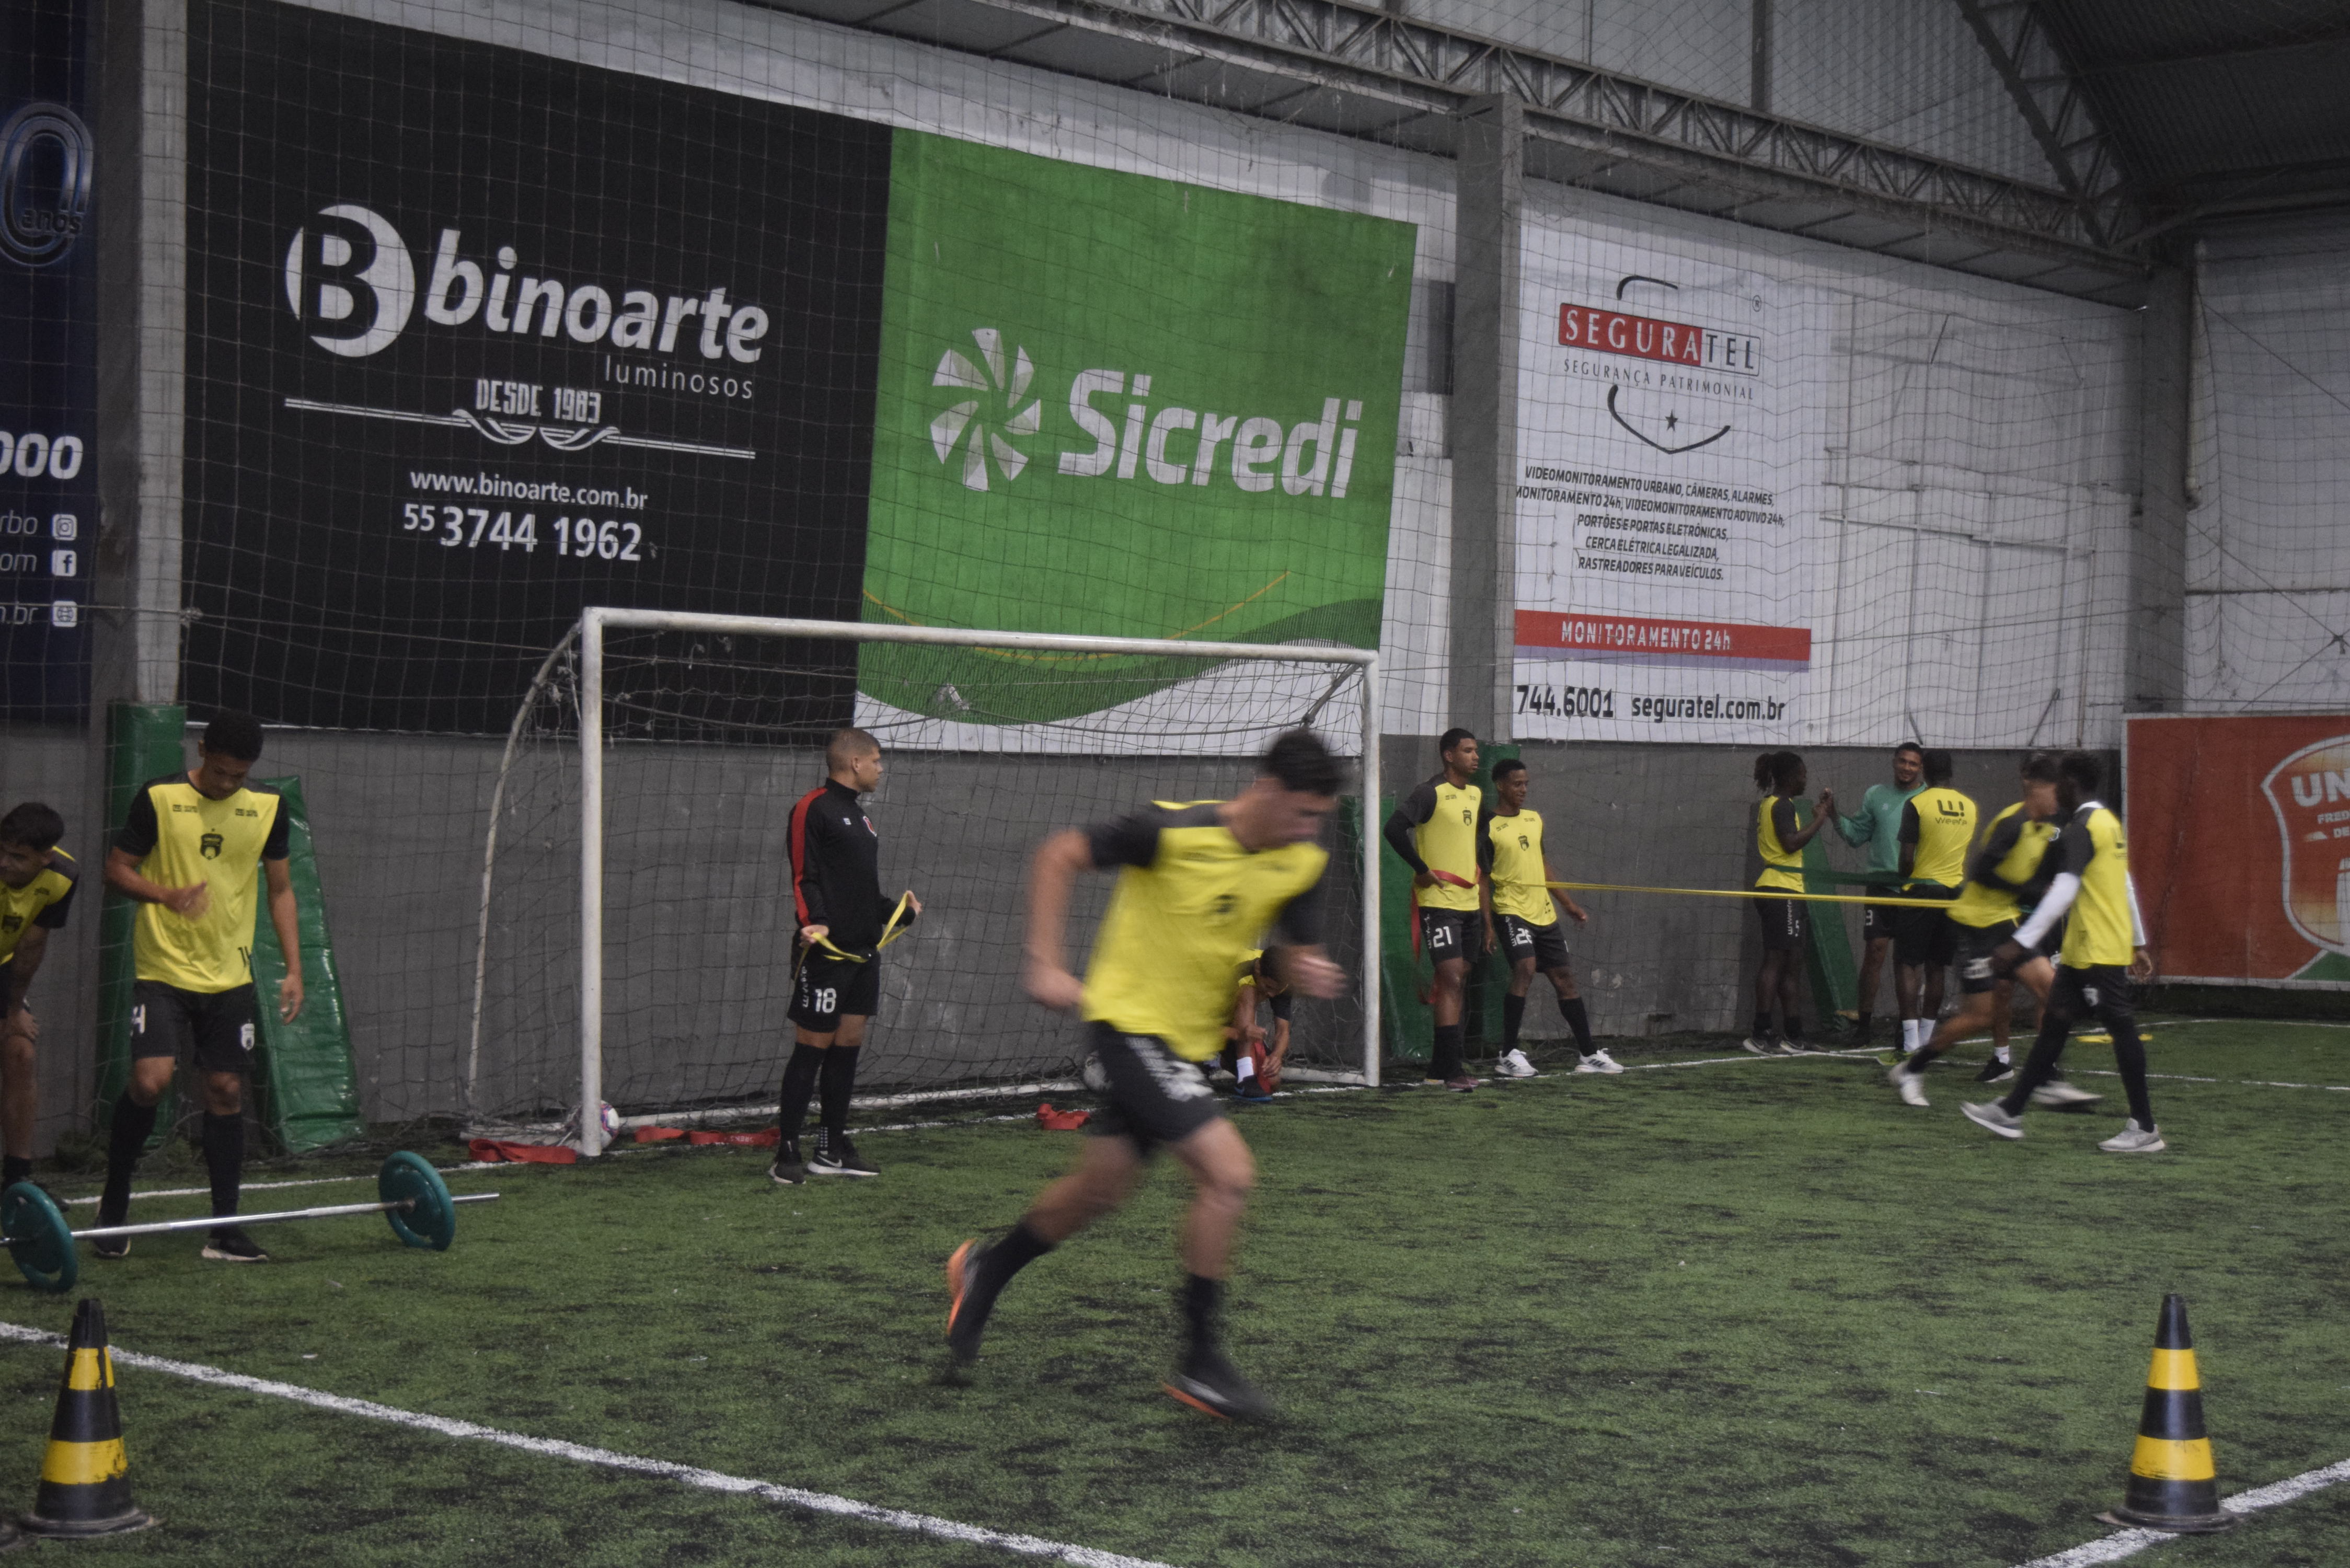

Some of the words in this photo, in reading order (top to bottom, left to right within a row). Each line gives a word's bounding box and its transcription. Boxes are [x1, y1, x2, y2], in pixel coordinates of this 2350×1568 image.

[21, 209, 82, 236] anos
[425, 228, 769, 363] binoarte
[1565, 309, 1754, 370] SEGURATEL
[605, 355, 753, 399] luminosos
[1564, 359, 1650, 386] SEGURANÇA
[1661, 373, 1753, 400] PATRIMONIAL
[476, 379, 543, 417] DESDE
[554, 387, 601, 424] 1983
[1058, 368, 1363, 498] Sicredi
[410, 471, 648, 510] www.binoarte.com.br
[1525, 465, 1642, 490] VIDEOMONITORAMENTO
[1643, 480, 1684, 498] URBANO,
[1685, 482, 1730, 503] CÂMERAS,
[1731, 490, 1775, 507] ALARMES,
[1516, 486, 1602, 506] MONITORAMENTO
[1603, 495, 1623, 511] 24h,
[1625, 498, 1733, 521] VIDEOMONITORAMENTO
[1767, 513, 1785, 528] 24h,
[404, 503, 435, 532] 55
[440, 506, 538, 552] 3744
[552, 516, 642, 561] 1962
[1577, 514, 1621, 531] PORTÕES
[1622, 518, 1629, 531] E
[1629, 520, 1665, 534] PORTAS
[1666, 523, 1729, 543] ELETRÔNICAS,
[1585, 536, 1616, 550] CERCA
[1617, 537, 1662, 555] ELÉTRICA
[1662, 544, 1720, 561] LEGALIZADA,
[1578, 556, 1653, 574] RASTREADORES
[1654, 563, 1679, 577] PARA
[1679, 563, 1723, 581] VEÍCULOS.
[1562, 620, 1700, 649] MONITORAMENTO
[1704, 629, 1731, 651] 24h
[1517, 685, 1614, 718] 744.6001
[1631, 694, 1785, 723] seguratel.com.br
[1433, 926, 1452, 948] 21
[815, 987, 837, 1013] 18
